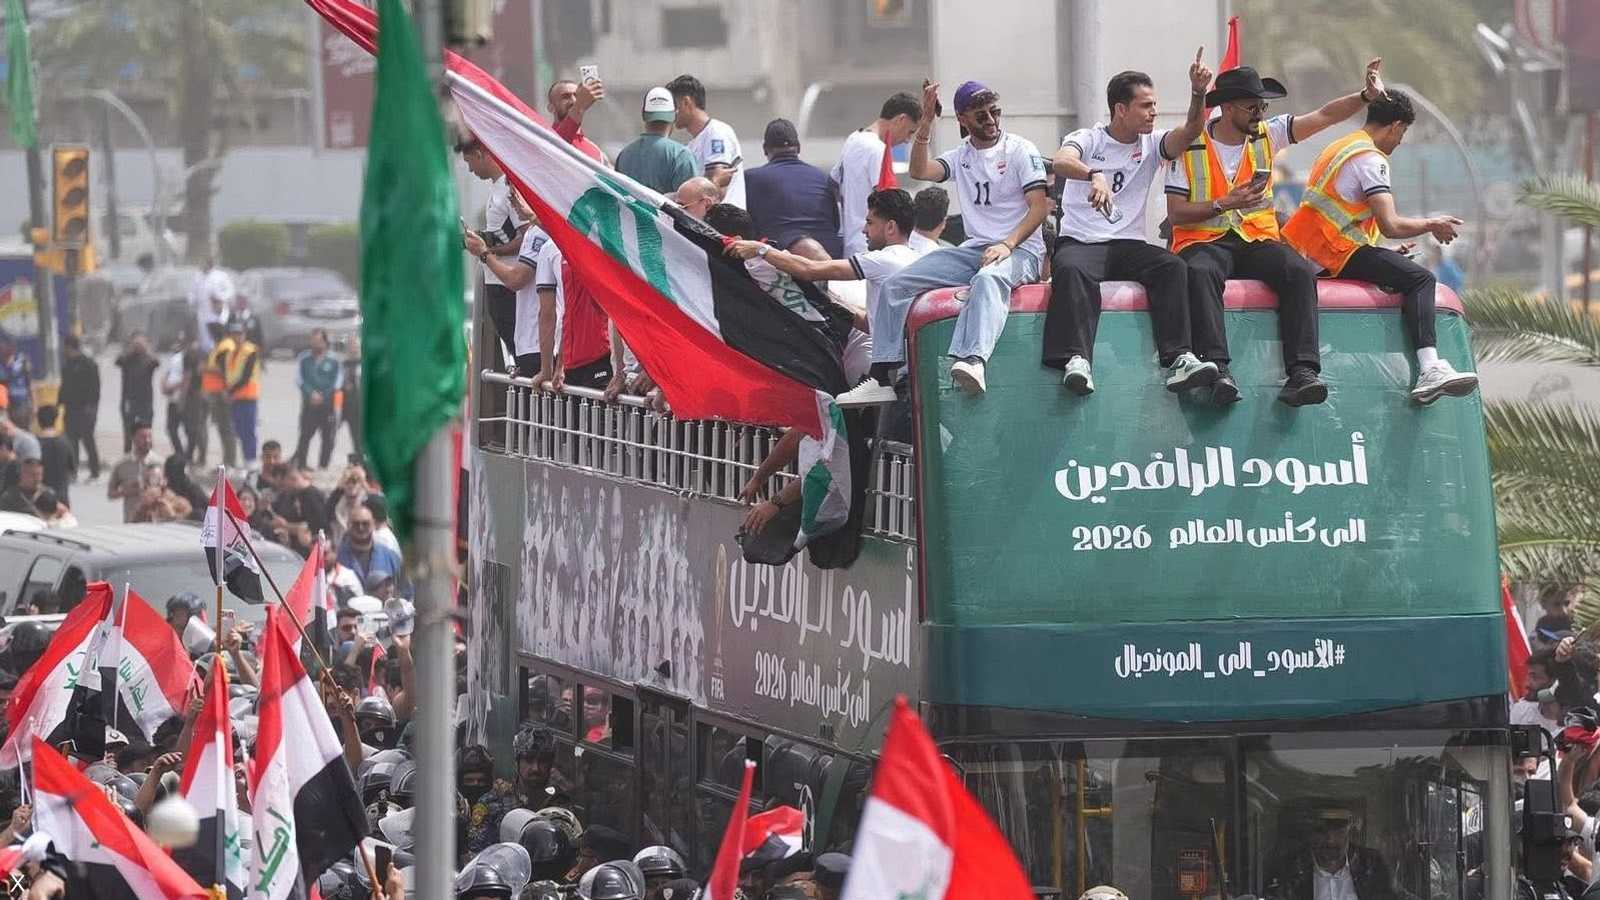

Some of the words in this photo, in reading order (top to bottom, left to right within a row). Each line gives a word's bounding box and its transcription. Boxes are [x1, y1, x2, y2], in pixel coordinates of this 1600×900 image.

[973, 181, 993, 207] 11
[1112, 170, 1125, 194] 8
[1054, 446, 1236, 503] الرافدين
[1241, 431, 1369, 495] أسود
[1072, 524, 1152, 551] 2026
[1169, 518, 1244, 549] العالم
[1246, 511, 1317, 548] كأس
[840, 546, 913, 672] أسود
[754, 650, 787, 701] 2026
[790, 659, 821, 708] العالم
